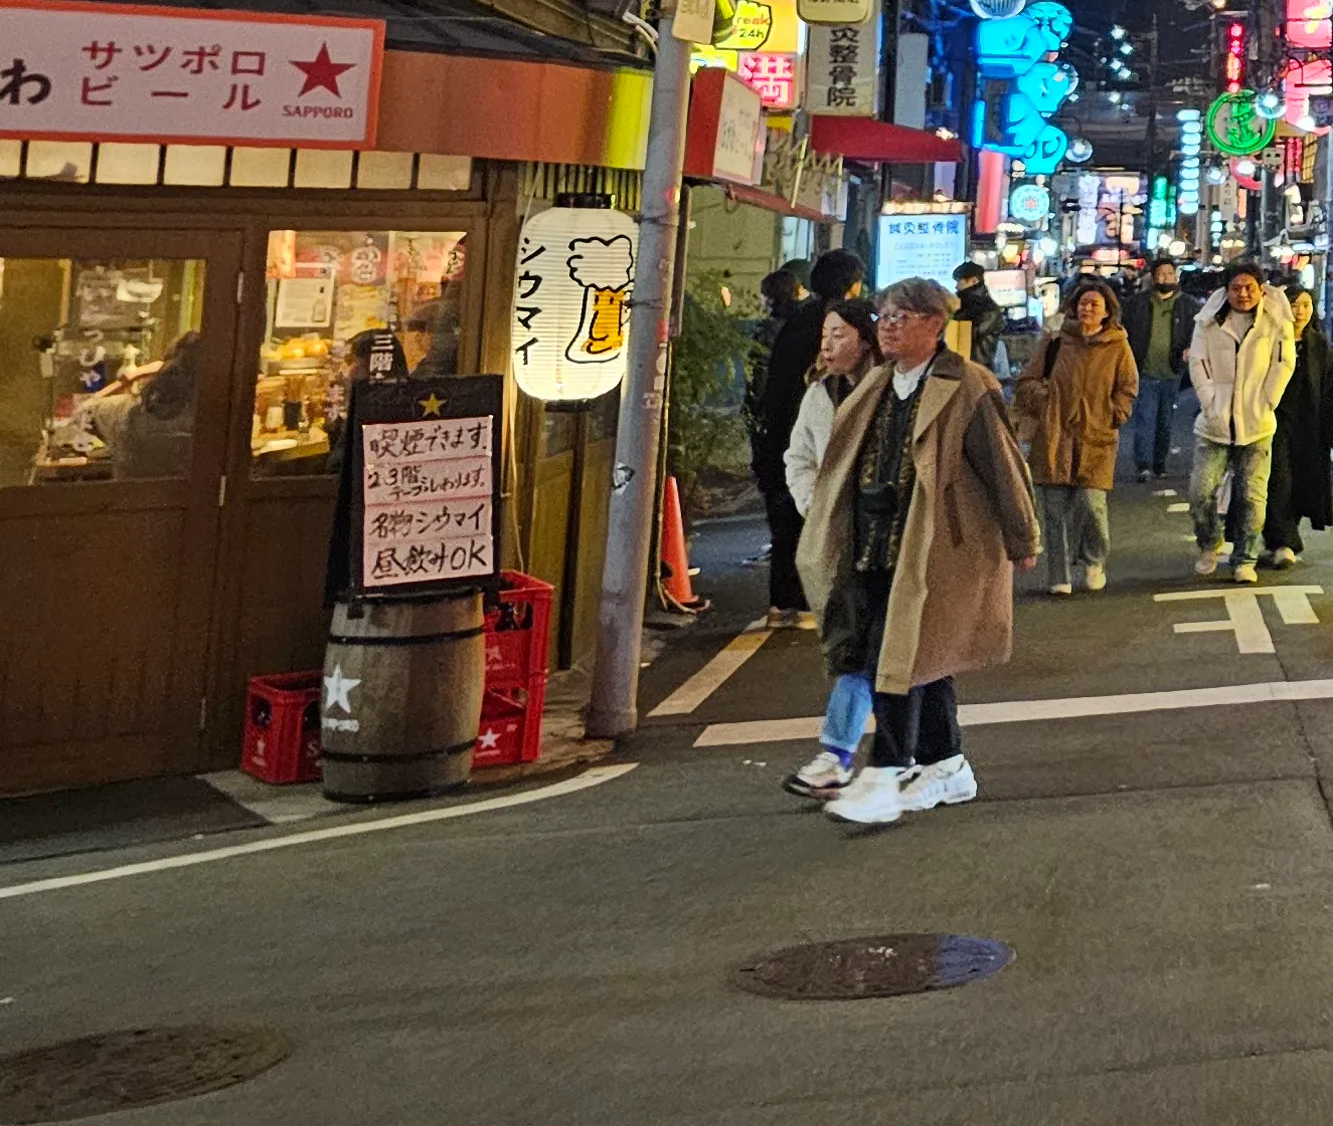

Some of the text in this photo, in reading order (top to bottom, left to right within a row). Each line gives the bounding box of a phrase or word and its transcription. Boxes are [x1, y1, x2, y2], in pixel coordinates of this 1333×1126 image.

[81, 76, 263, 111] ビール
[282, 104, 354, 120] SAPPORO
[516, 237, 546, 367] シウマイ
[369, 503, 486, 539] 名物シウマイ
[371, 540, 488, 579] 昼飲みOK
